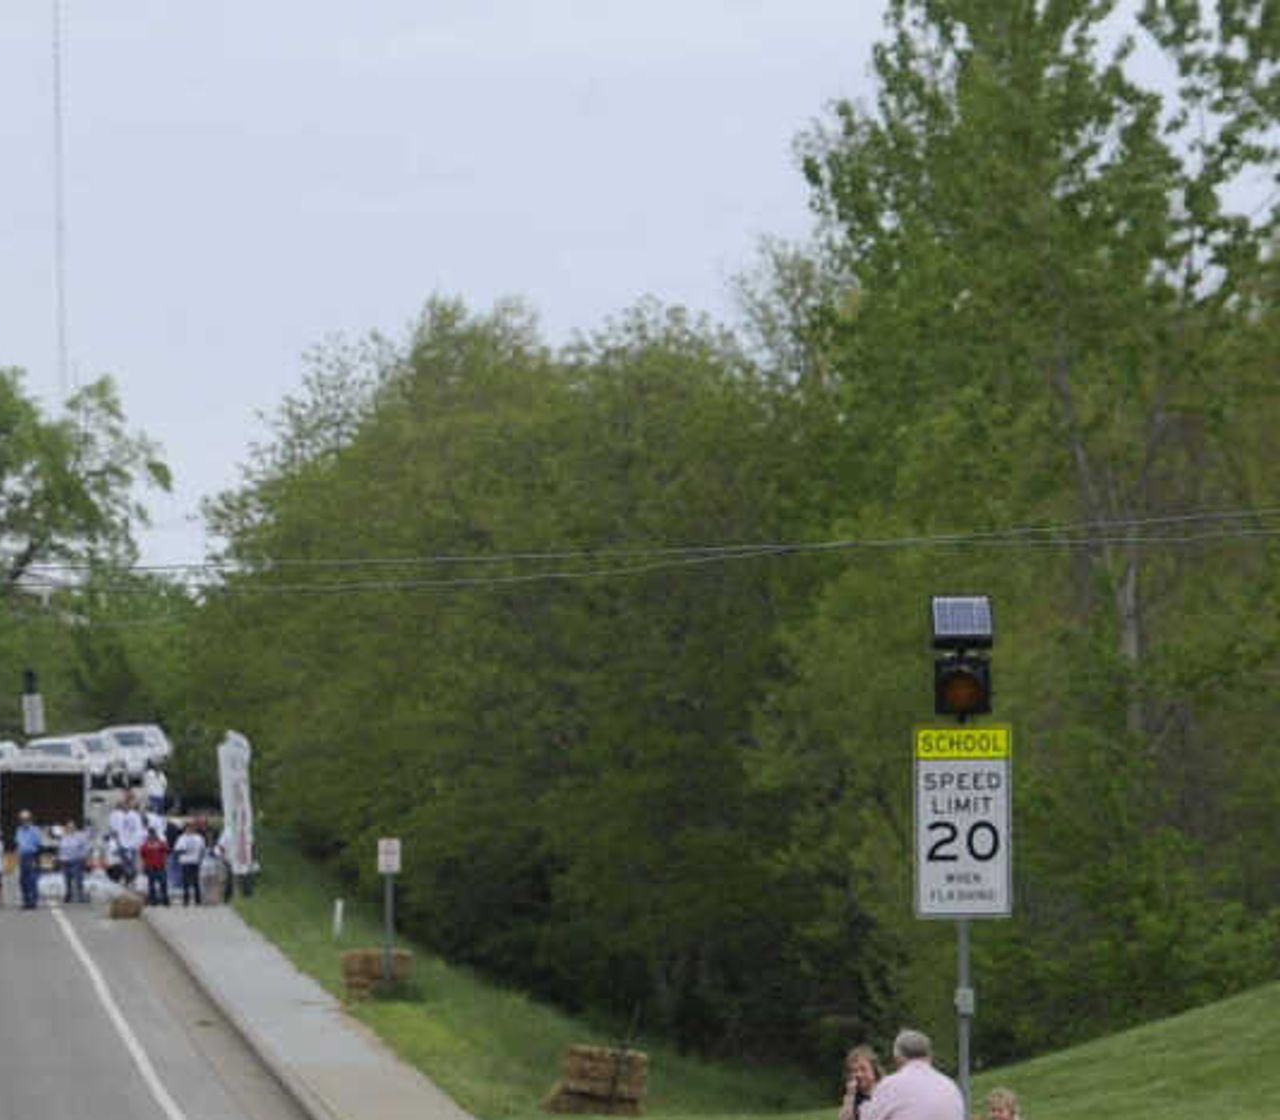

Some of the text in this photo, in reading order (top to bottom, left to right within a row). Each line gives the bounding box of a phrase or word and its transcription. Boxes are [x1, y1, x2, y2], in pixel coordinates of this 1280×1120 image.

[921, 733, 1003, 753] SCHOOL
[923, 772, 1001, 791] SPEED
[931, 796, 993, 815] LIMIT
[926, 820, 1000, 862] 20
